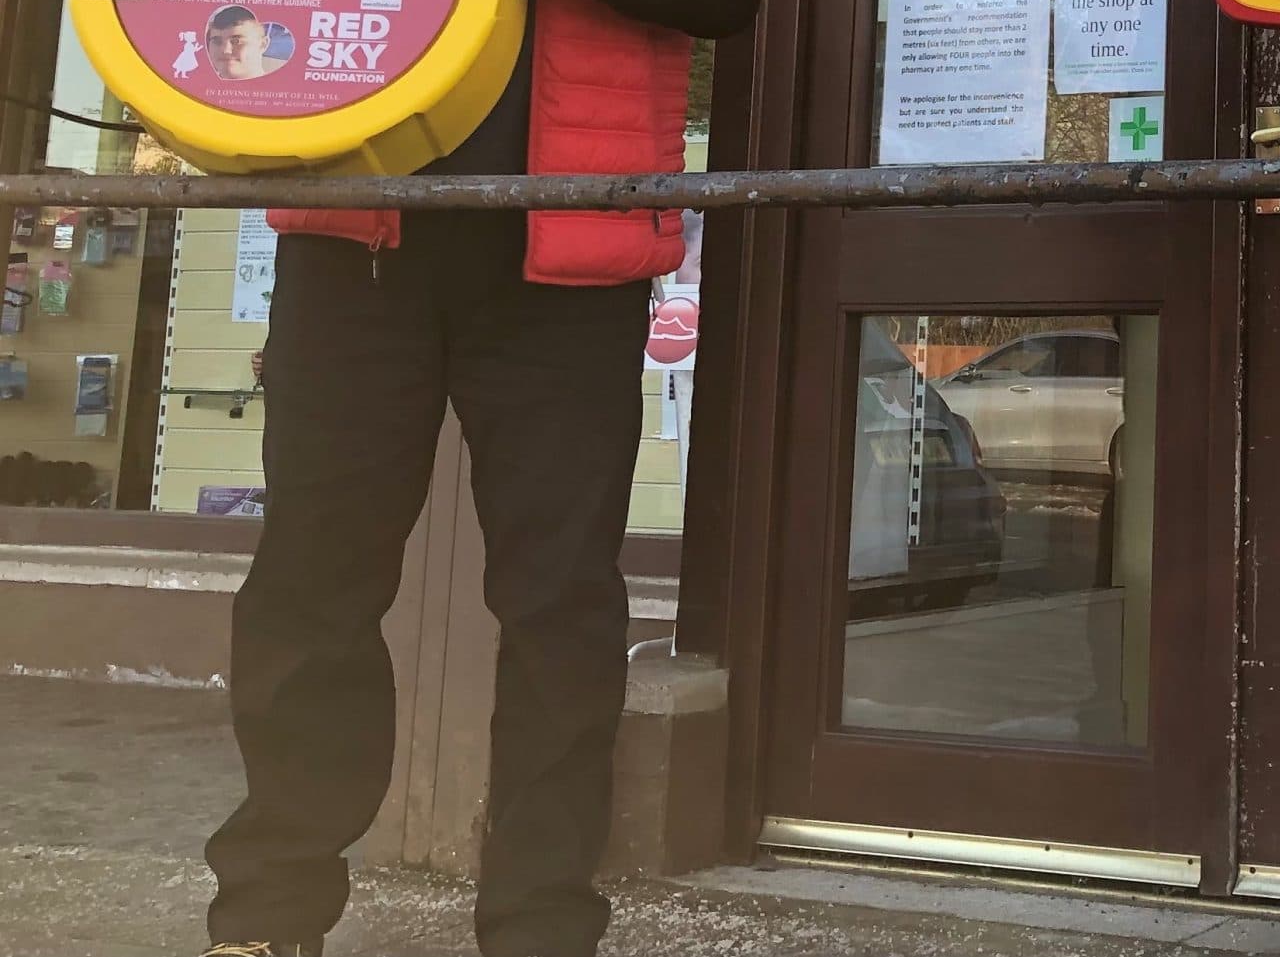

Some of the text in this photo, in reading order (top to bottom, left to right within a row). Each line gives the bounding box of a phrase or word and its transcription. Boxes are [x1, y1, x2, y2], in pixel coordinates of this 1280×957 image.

[904, 12, 1027, 24] Government's recommendation
[309, 11, 390, 40] RED
[919, 28, 942, 37] people
[944, 27, 967, 35] should
[969, 26, 983, 34] stay
[1005, 24, 1021, 32] than
[1081, 19, 1142, 37] any one
[959, 39, 975, 47] from
[902, 54, 916, 62] only
[919, 52, 948, 61] allowing
[971, 50, 995, 59] people
[997, 49, 1012, 57] into
[1091, 41, 1129, 58] time.
[306, 42, 385, 70] SKY
[901, 67, 934, 76] pharmacy
[945, 65, 957, 73] any
[305, 72, 385, 84] FOUNDATION
[253, 91, 289, 99] MEMORY
[914, 95, 945, 104] apologise
[960, 93, 971, 101] the
[974, 92, 1024, 101] inconvenience
[949, 108, 963, 116] you
[967, 105, 1007, 114] understand
[926, 120, 951, 128] protect
[953, 120, 981, 128] patients
